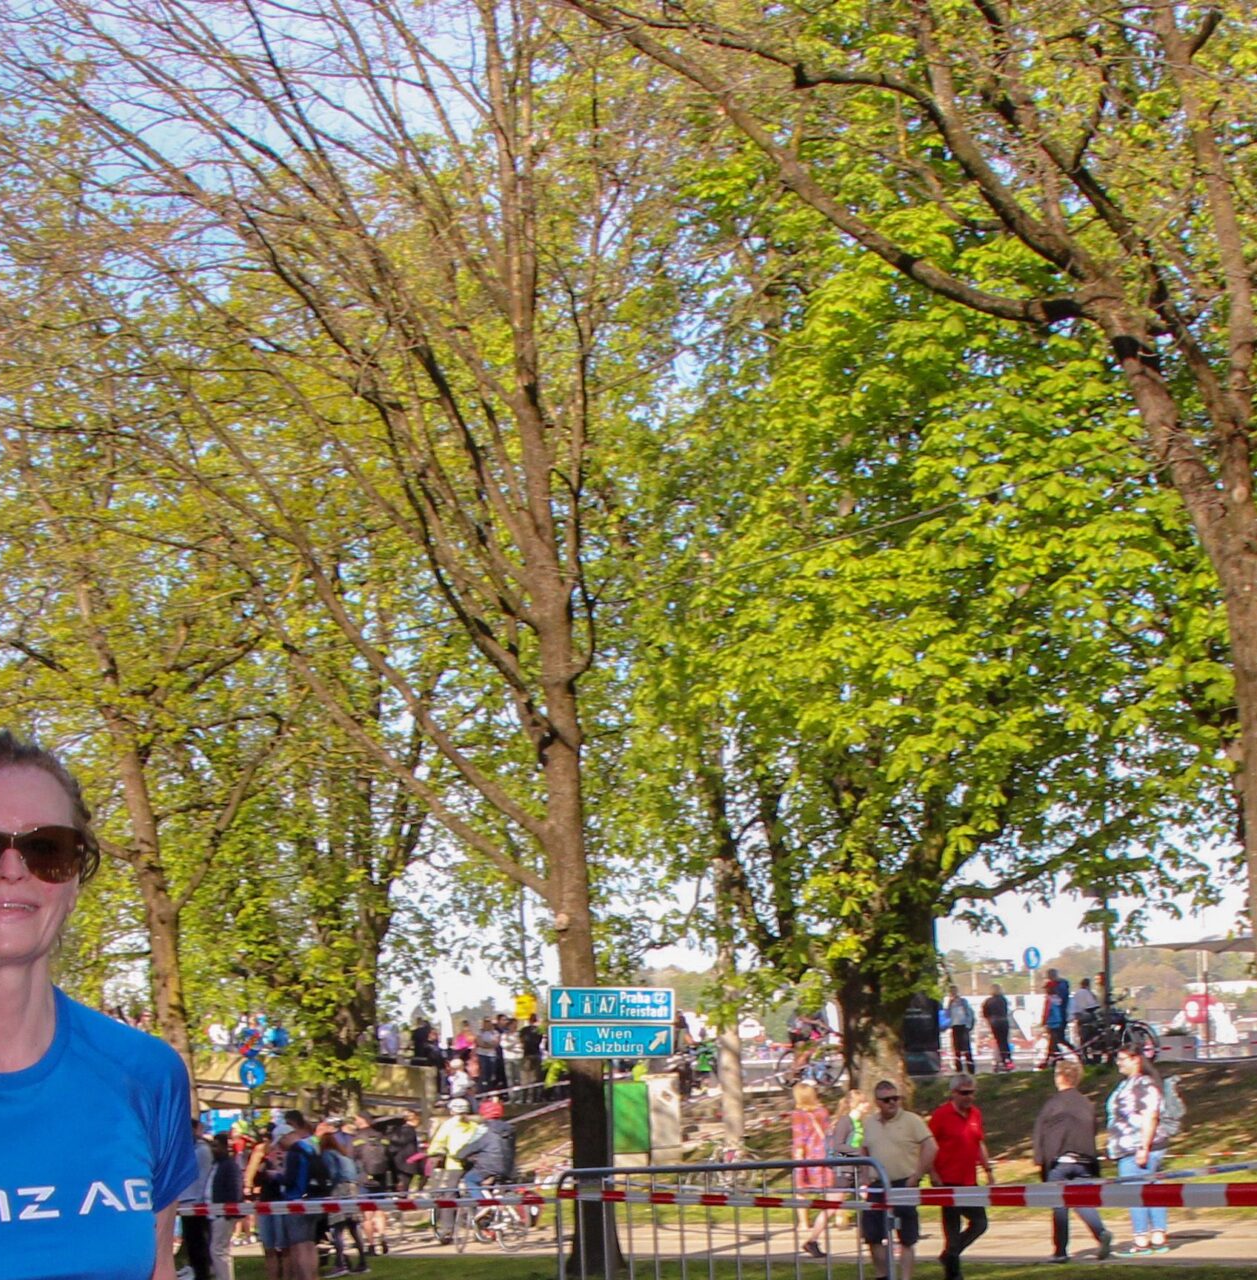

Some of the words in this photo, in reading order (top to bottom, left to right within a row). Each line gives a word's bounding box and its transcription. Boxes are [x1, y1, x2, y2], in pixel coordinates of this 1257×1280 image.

[599, 996, 616, 1013] A7
[620, 992, 651, 1004] Praha
[620, 1005, 668, 1017] Freistadt
[596, 1028, 632, 1039] Wien
[585, 1041, 644, 1056] Salzburg
[79, 1179, 152, 1215] AG
